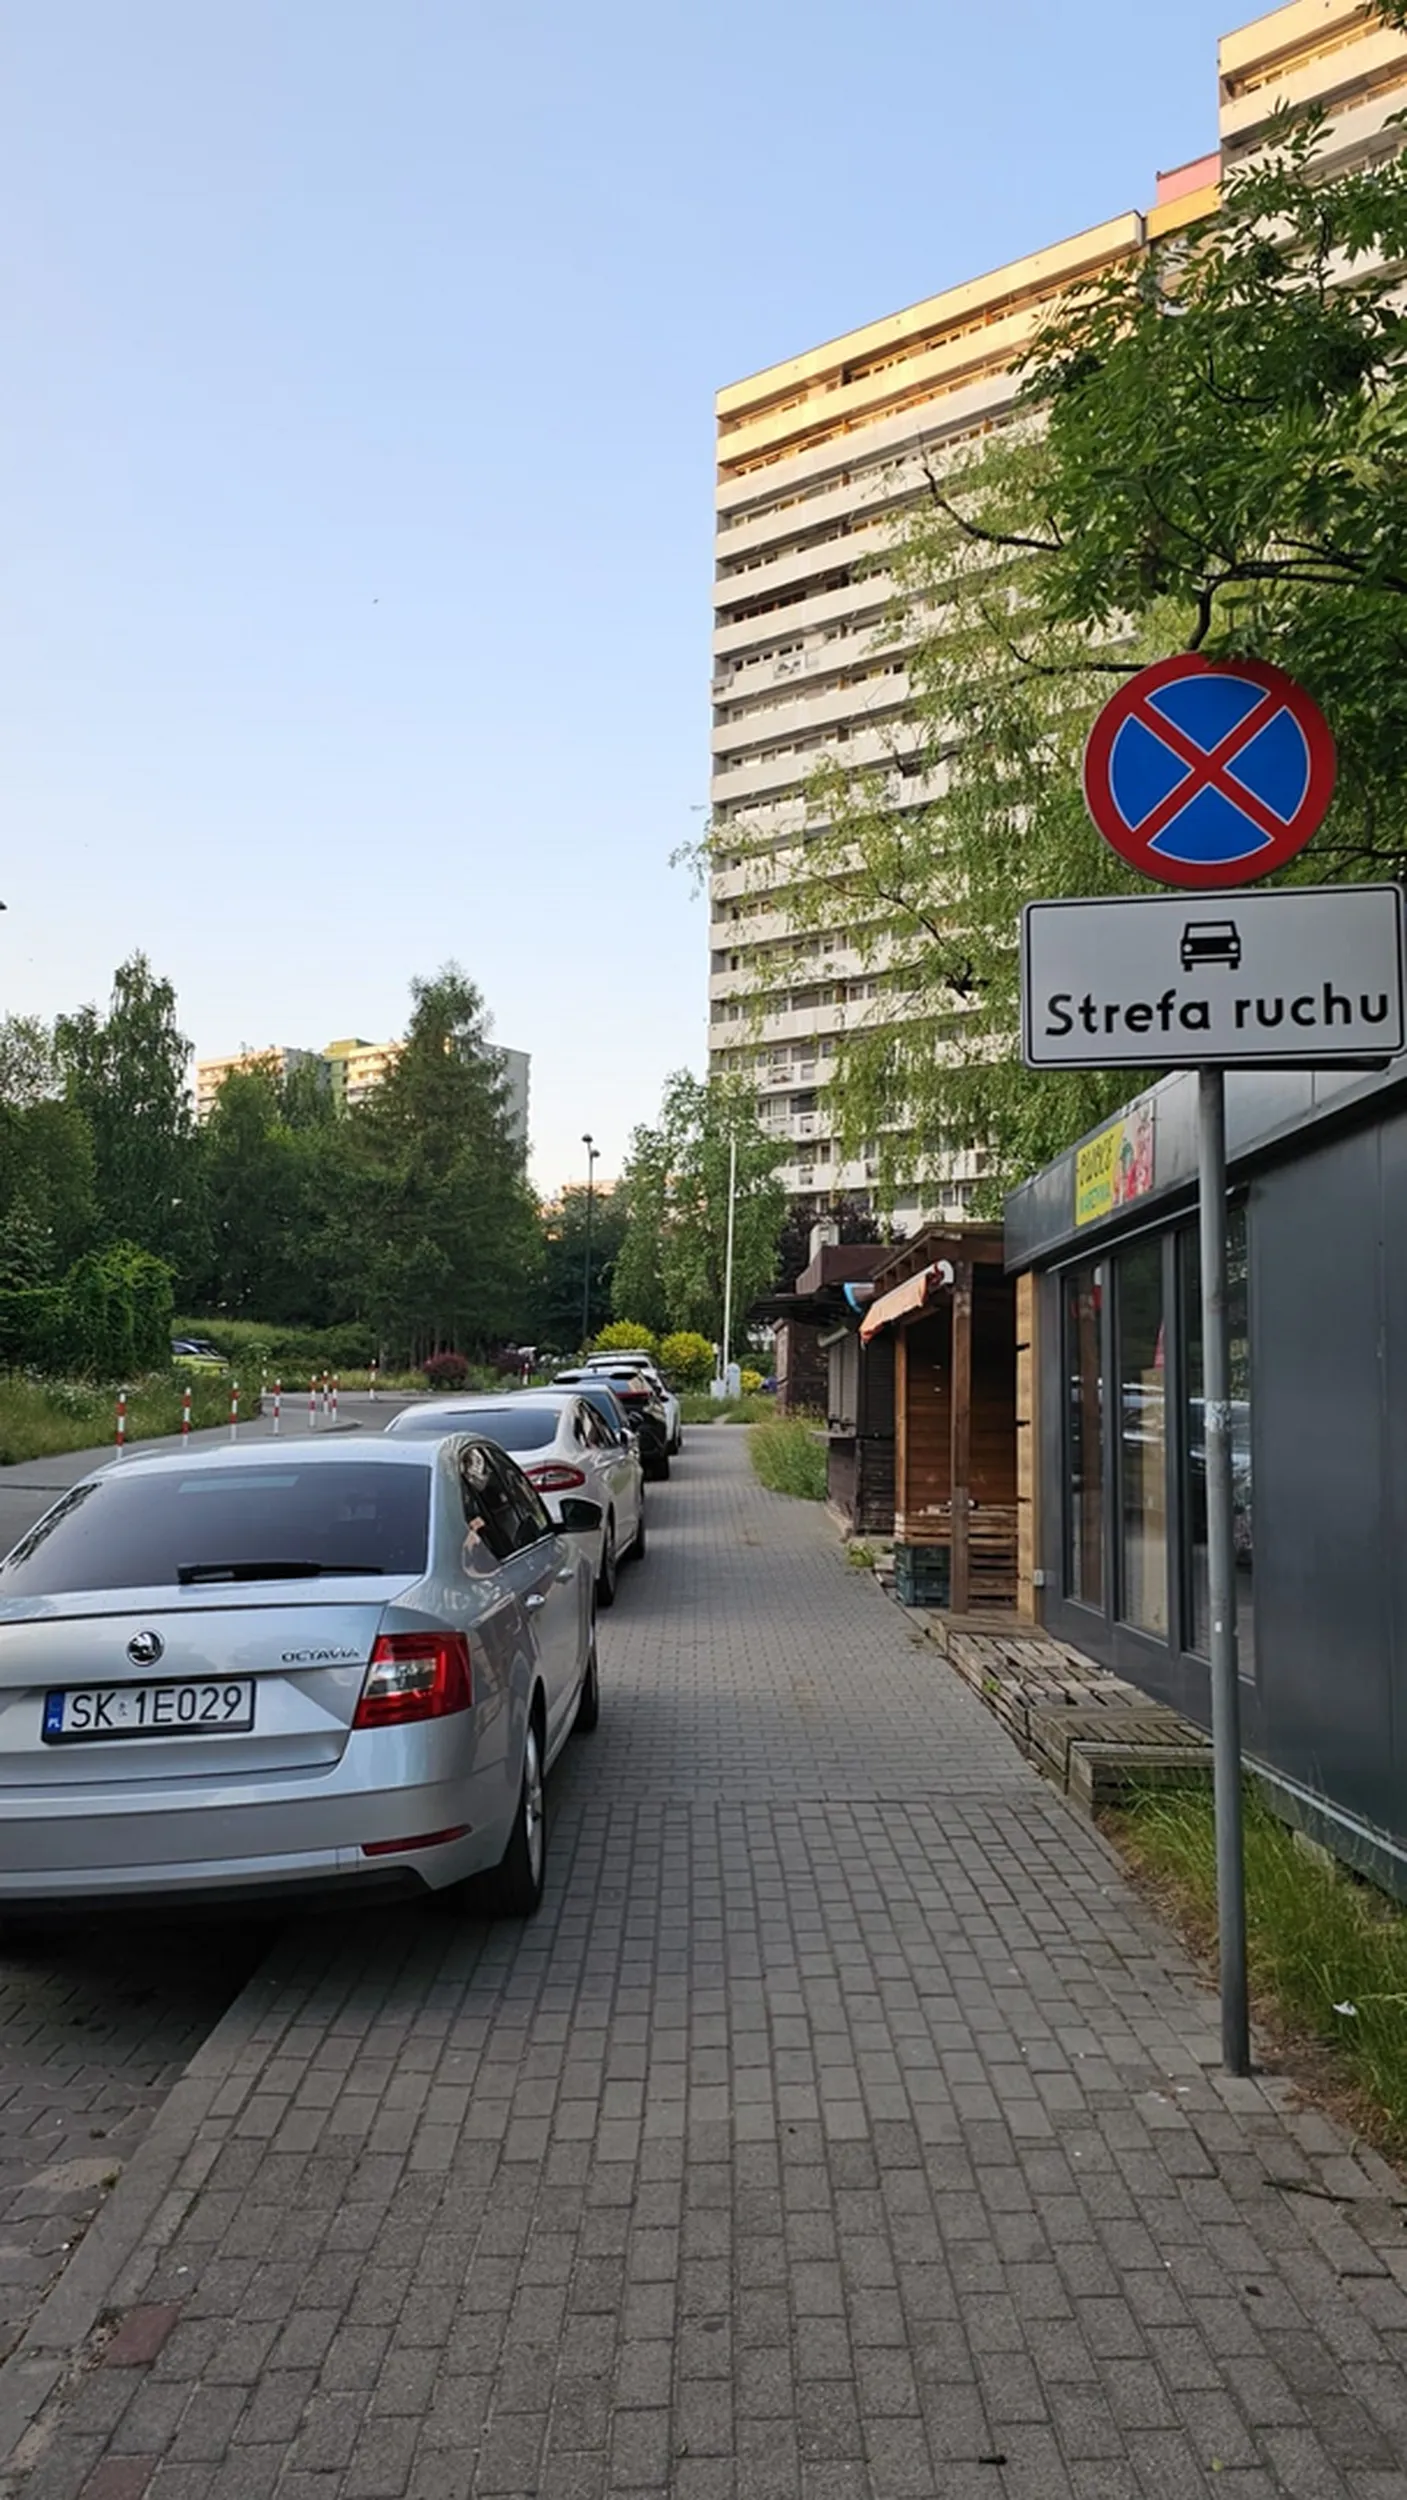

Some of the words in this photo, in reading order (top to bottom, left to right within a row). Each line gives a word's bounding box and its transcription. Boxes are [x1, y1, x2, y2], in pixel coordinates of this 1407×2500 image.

[1045, 988, 1211, 1036] Strefa
[1235, 982, 1389, 1029] ruchu
[281, 1647, 360, 1663] OCTAVIA
[71, 1692, 116, 1728] SK
[135, 1685, 242, 1725] 1E029
